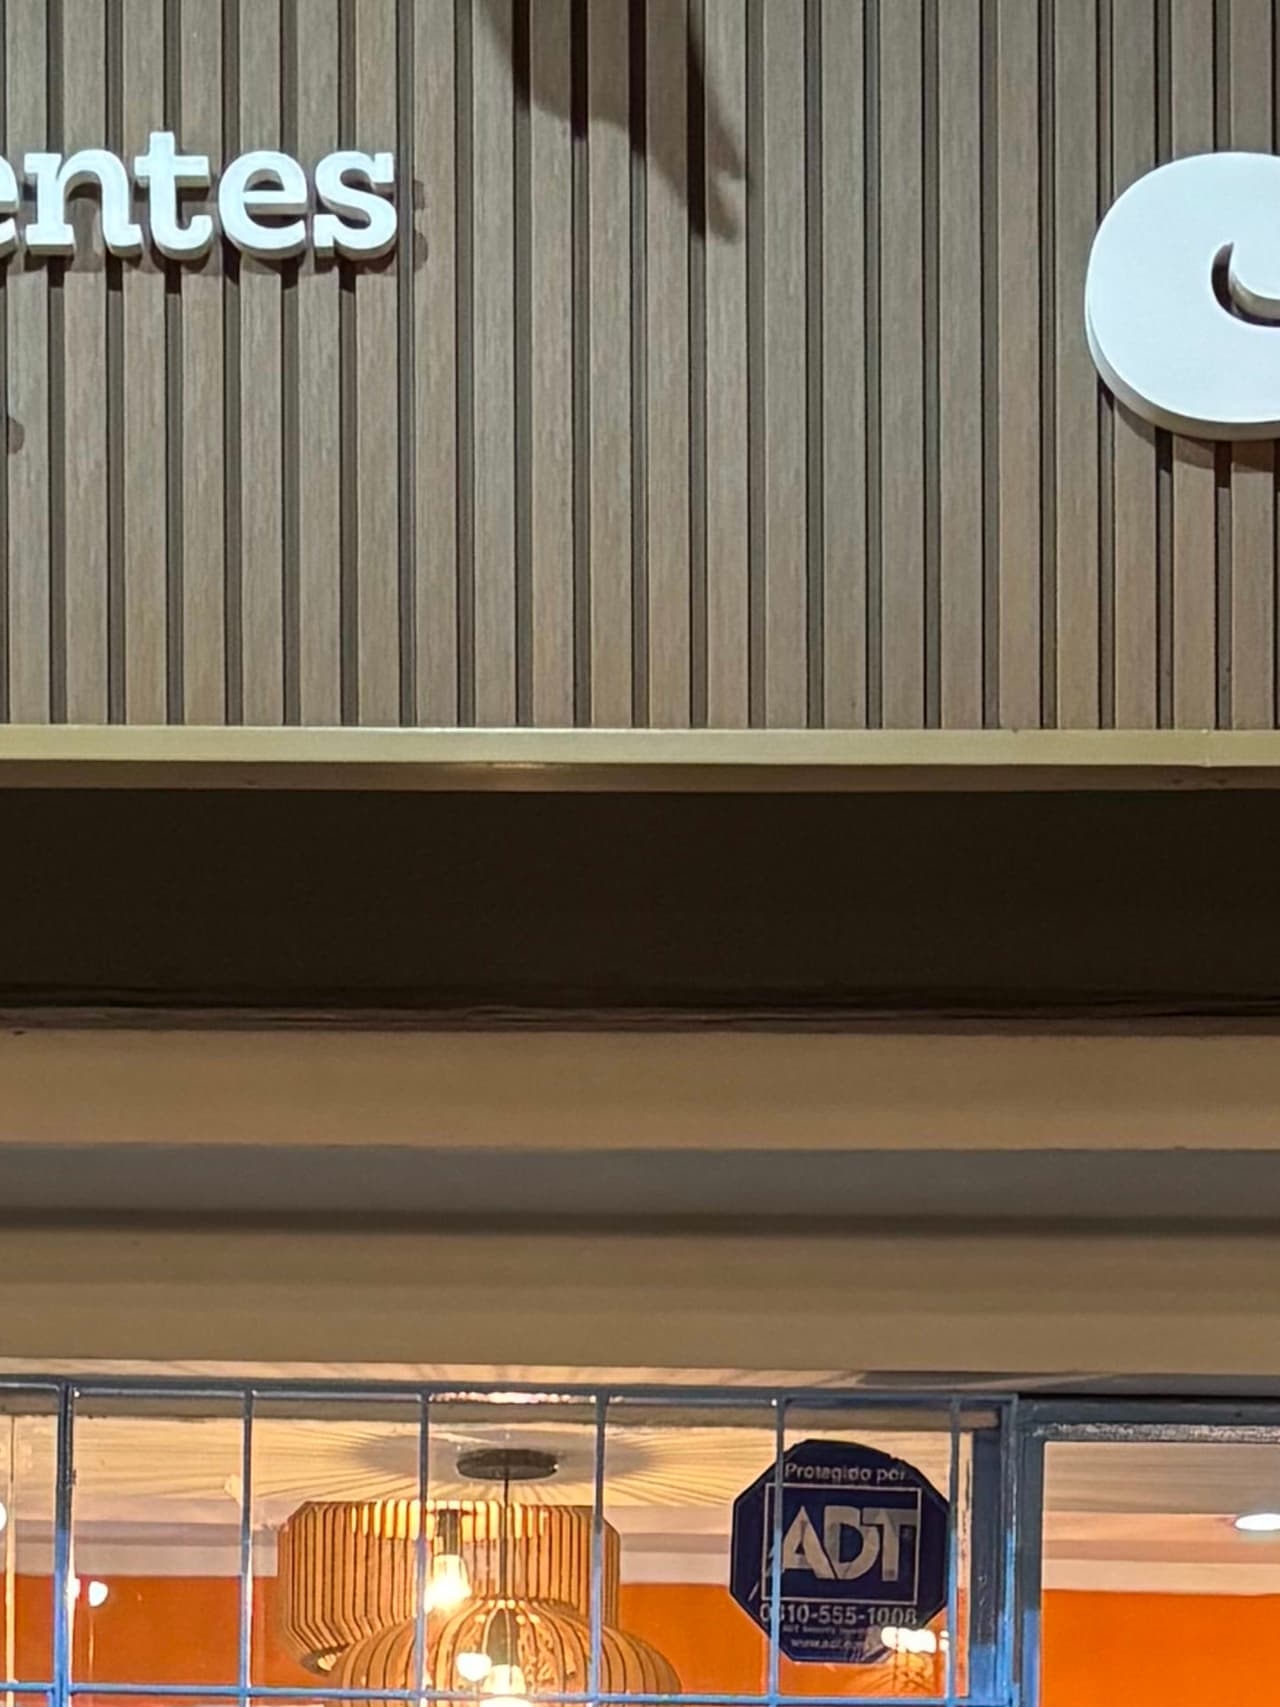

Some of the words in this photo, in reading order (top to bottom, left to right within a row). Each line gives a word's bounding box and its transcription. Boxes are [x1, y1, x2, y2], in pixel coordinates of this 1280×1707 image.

[785, 1462, 872, 1482] Protegido
[876, 1467, 906, 1484] por
[766, 1505, 919, 1581] ADT
[760, 1604, 917, 1625] 010-555-1008
